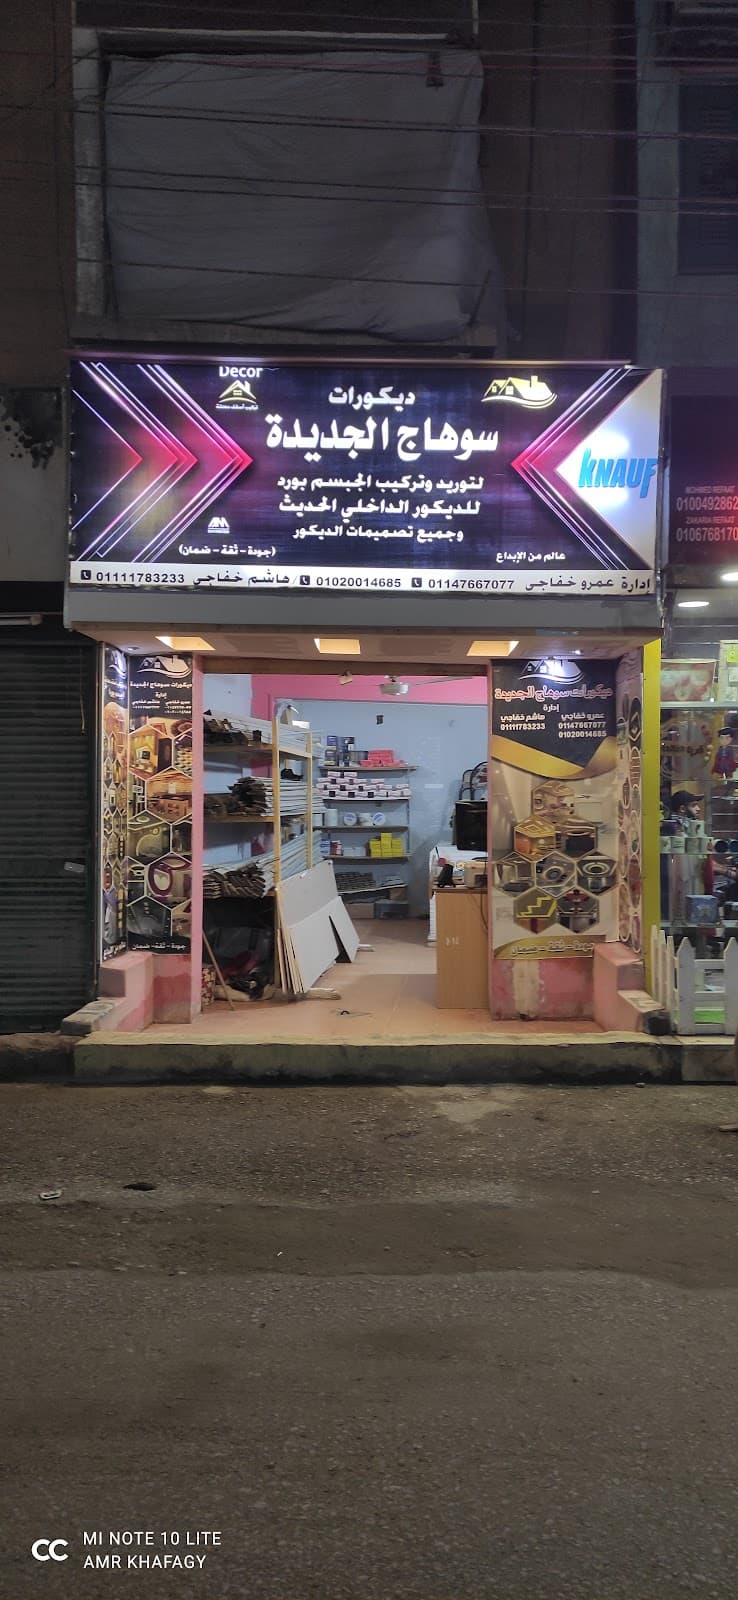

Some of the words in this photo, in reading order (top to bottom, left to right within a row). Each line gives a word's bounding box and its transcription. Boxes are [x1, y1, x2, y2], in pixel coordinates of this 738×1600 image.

[219, 366, 263, 378] Decor
[328, 386, 416, 411] ديكورات
[265, 414, 389, 462] الجديدة
[397, 417, 499, 461] سوهاج
[578, 449, 658, 498] KNAUF
[277, 476, 307, 491] بورد
[376, 474, 432, 493] وتركيب
[436, 476, 484, 493] لتوريد
[279, 494, 337, 517] الحديث
[341, 498, 409, 523] الداخلي
[412, 500, 480, 517] للديكور
[292, 524, 343, 540] الديكور
[346, 525, 413, 541] تصميمات
[417, 526, 464, 542] وجميع
[221, 544, 239, 555] ثقة
[527, 552, 542, 562] من
[544, 551, 566, 563] عالم
[96, 572, 185, 584] 01111783233
[248, 569, 290, 586] هاشم
[316, 577, 401, 588] 01020014685
[429, 579, 515, 590] 01147667077
[581, 576, 614, 591] عمرو
[620, 575, 650, 594] إدارة
[543, 704, 560, 713] إدارة
